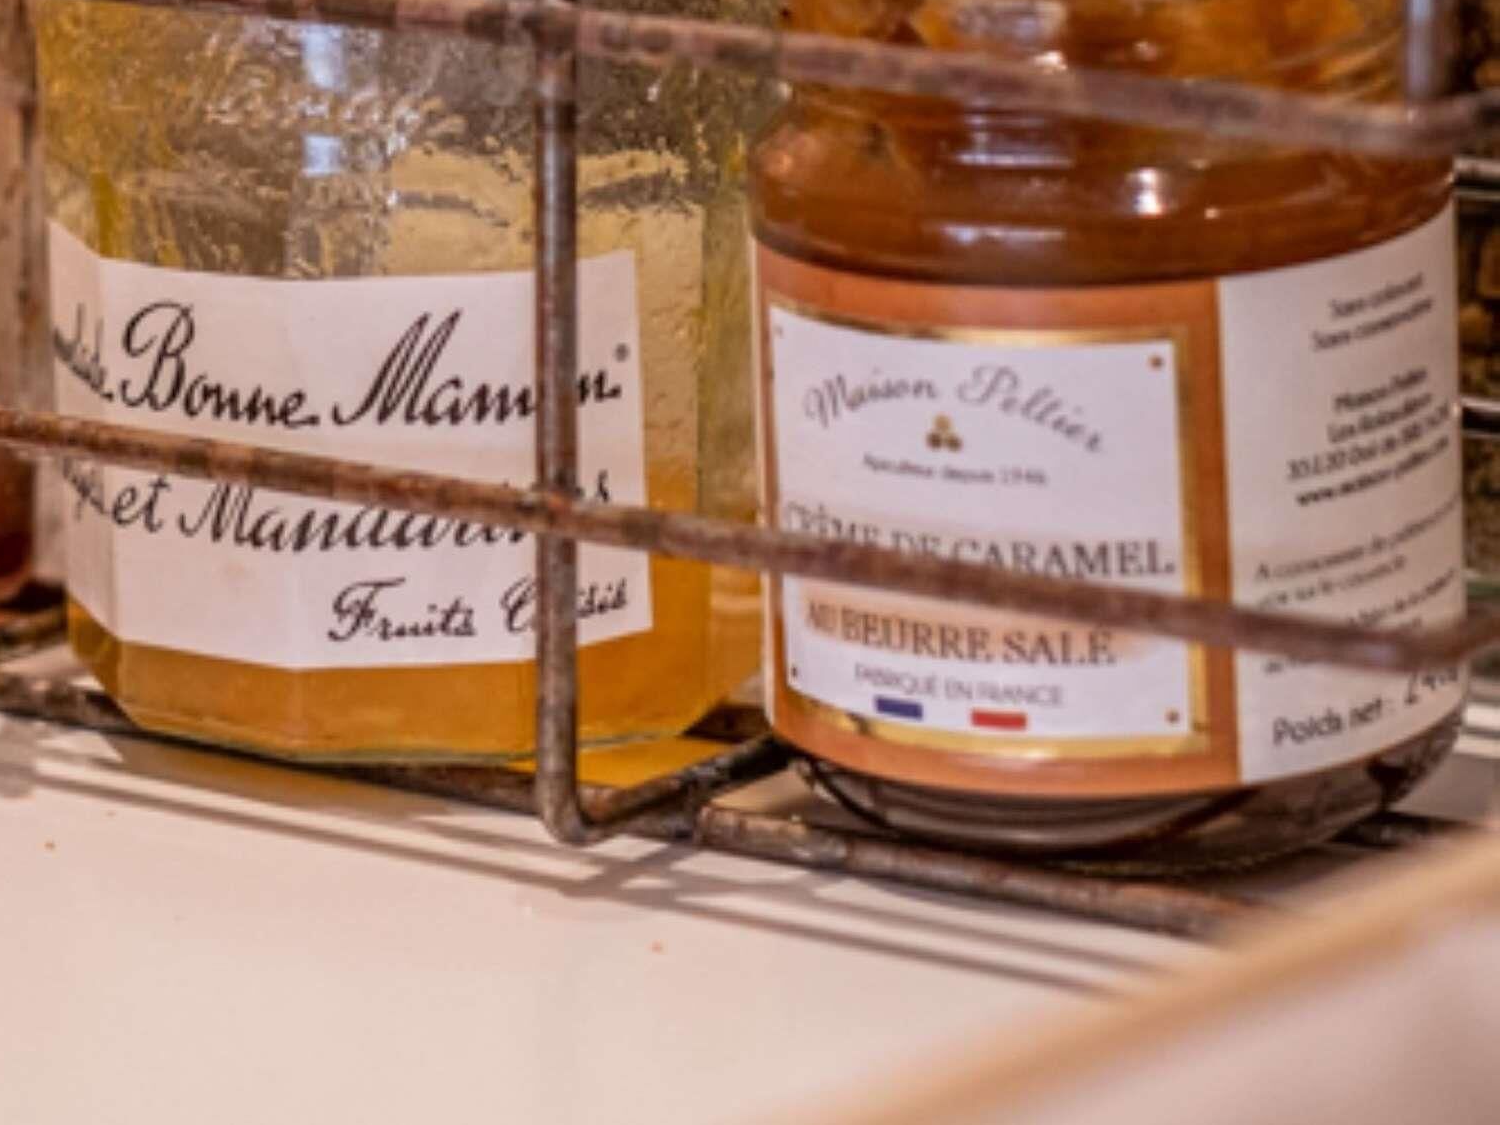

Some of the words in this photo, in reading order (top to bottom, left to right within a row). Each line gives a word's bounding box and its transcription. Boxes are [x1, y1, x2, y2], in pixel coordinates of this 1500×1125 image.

[121, 300, 319, 426] Bonne
[331, 308, 622, 426] Mamn
[803, 371, 938, 428] Maison
[953, 536, 1176, 579] CARAMEL
[327, 577, 476, 642] Fruits
[840, 602, 993, 662] BEURRE
